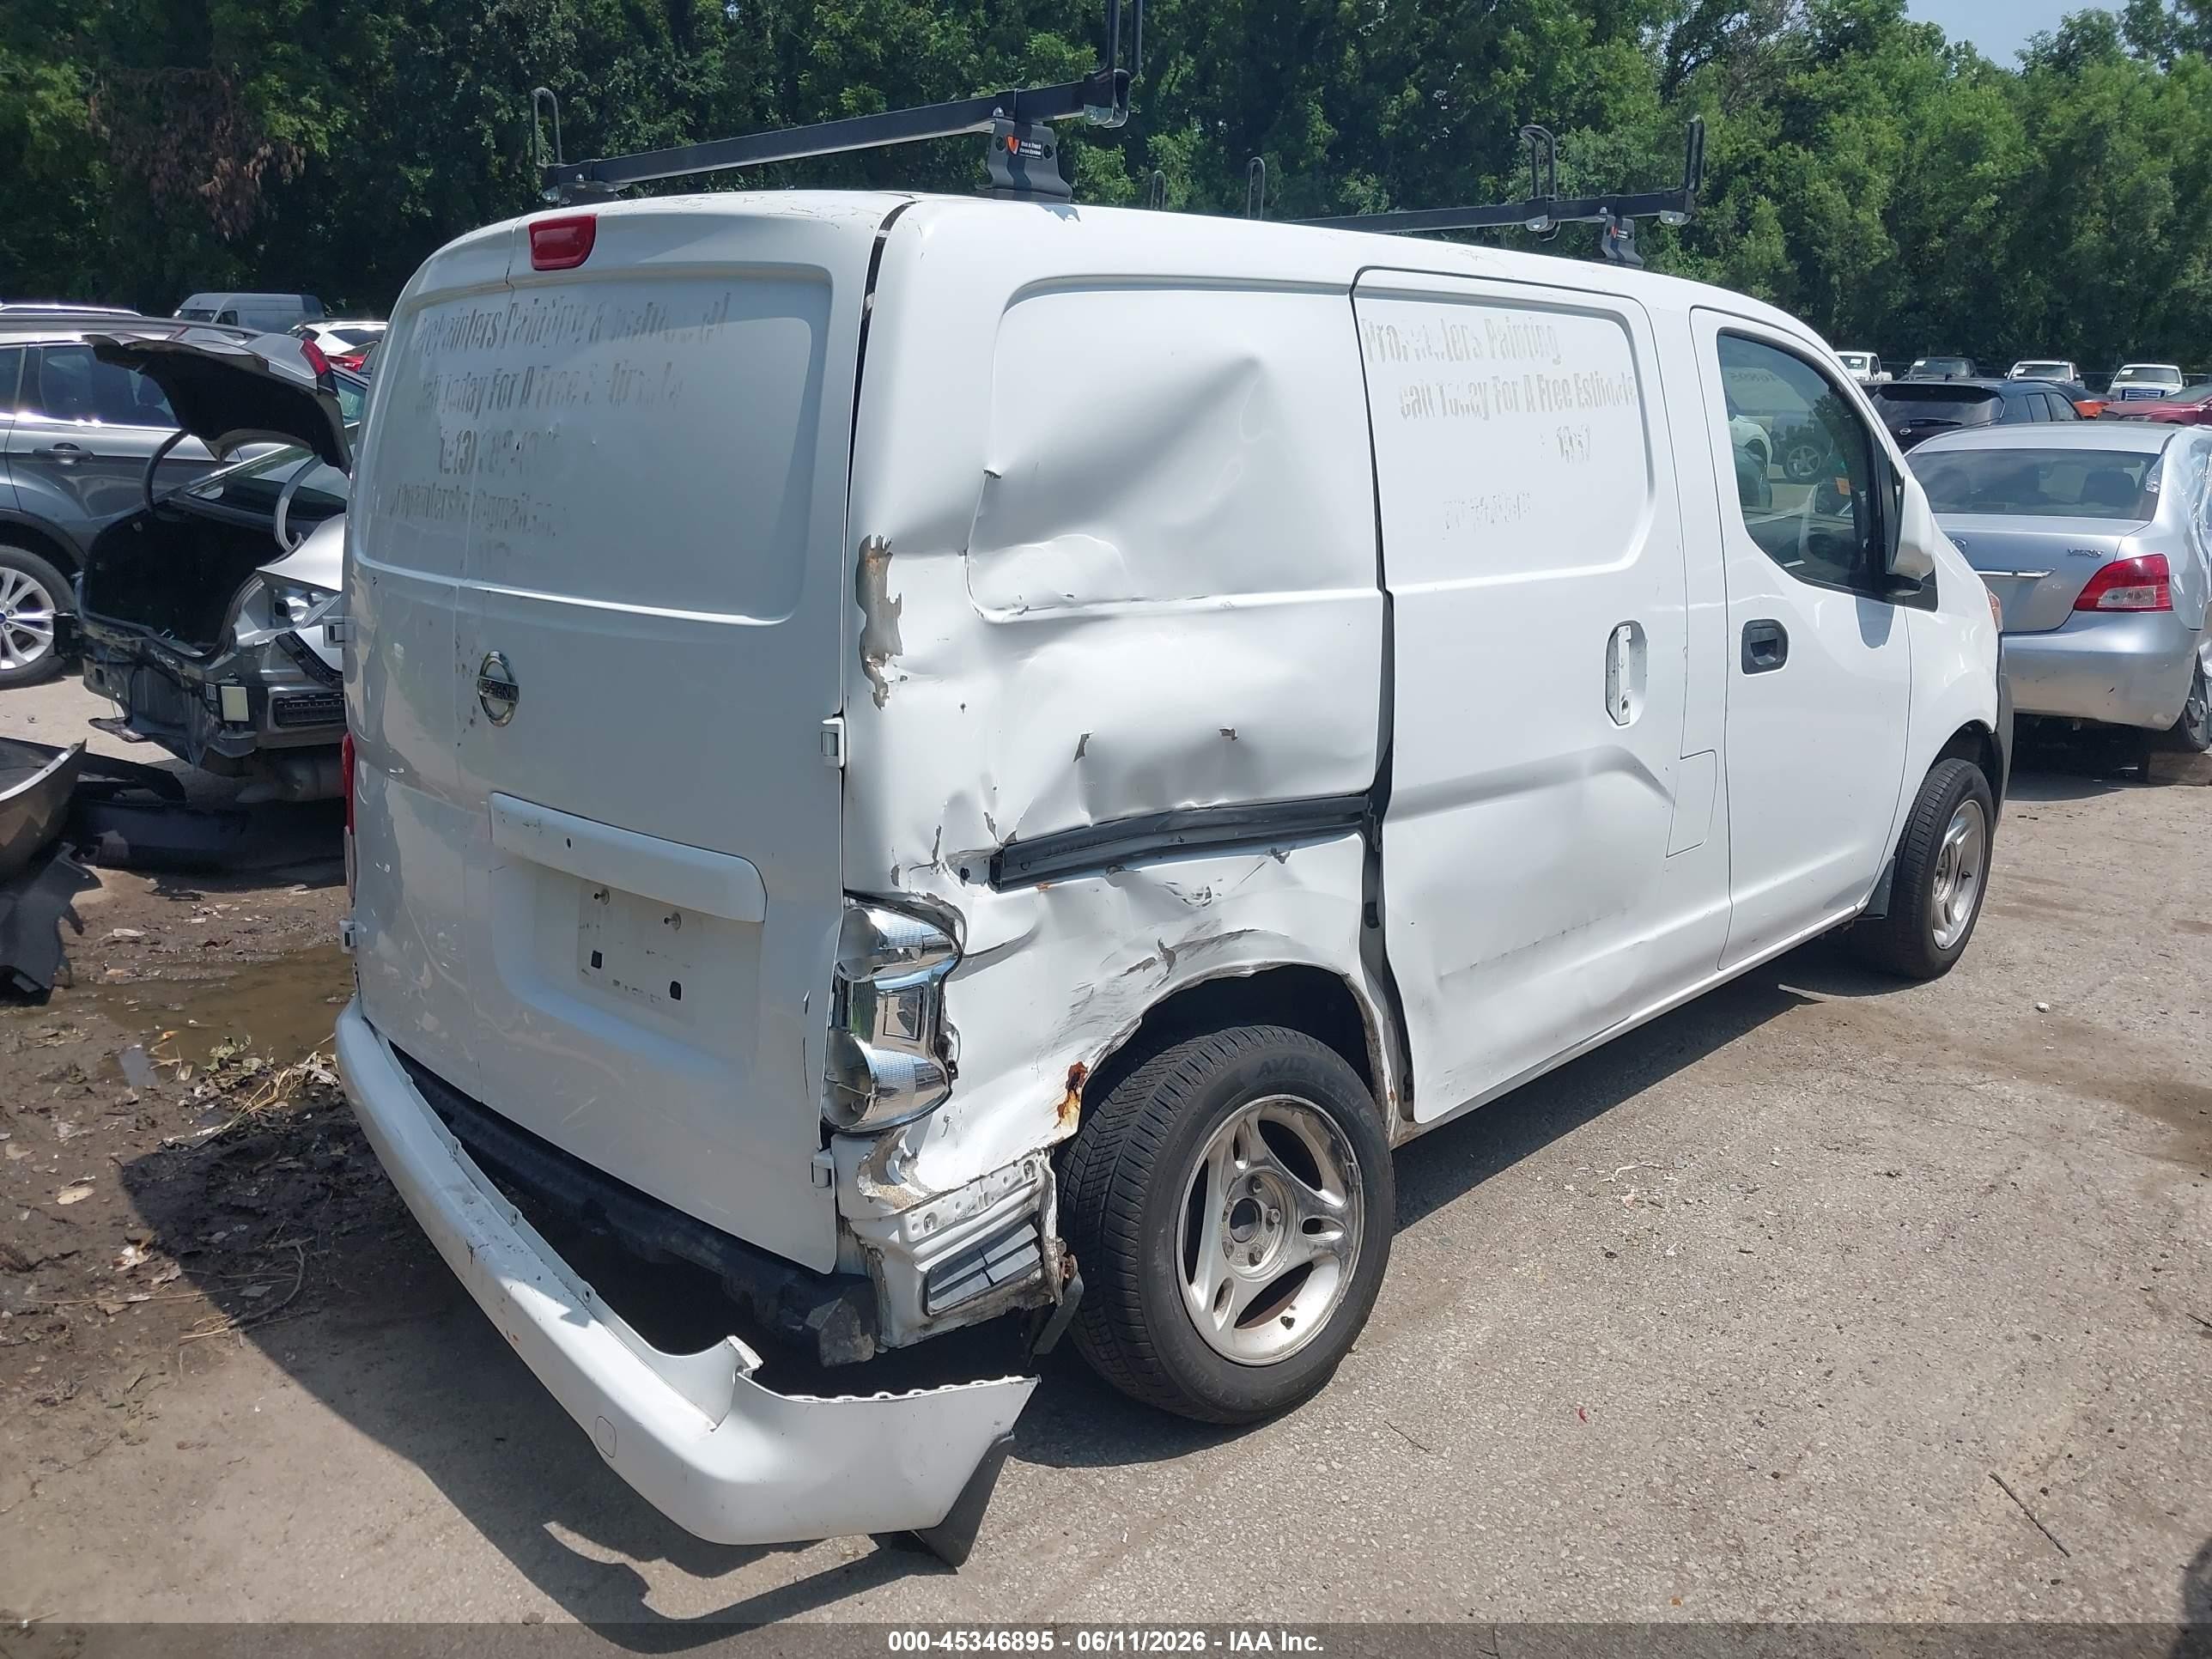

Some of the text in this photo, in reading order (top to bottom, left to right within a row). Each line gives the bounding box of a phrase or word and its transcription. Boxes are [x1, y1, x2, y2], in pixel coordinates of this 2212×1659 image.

[1484, 316, 1561, 365] Painting
[1491, 375, 1520, 415] For
[1522, 374, 1537, 412] A
[1536, 373, 1572, 413] Free
